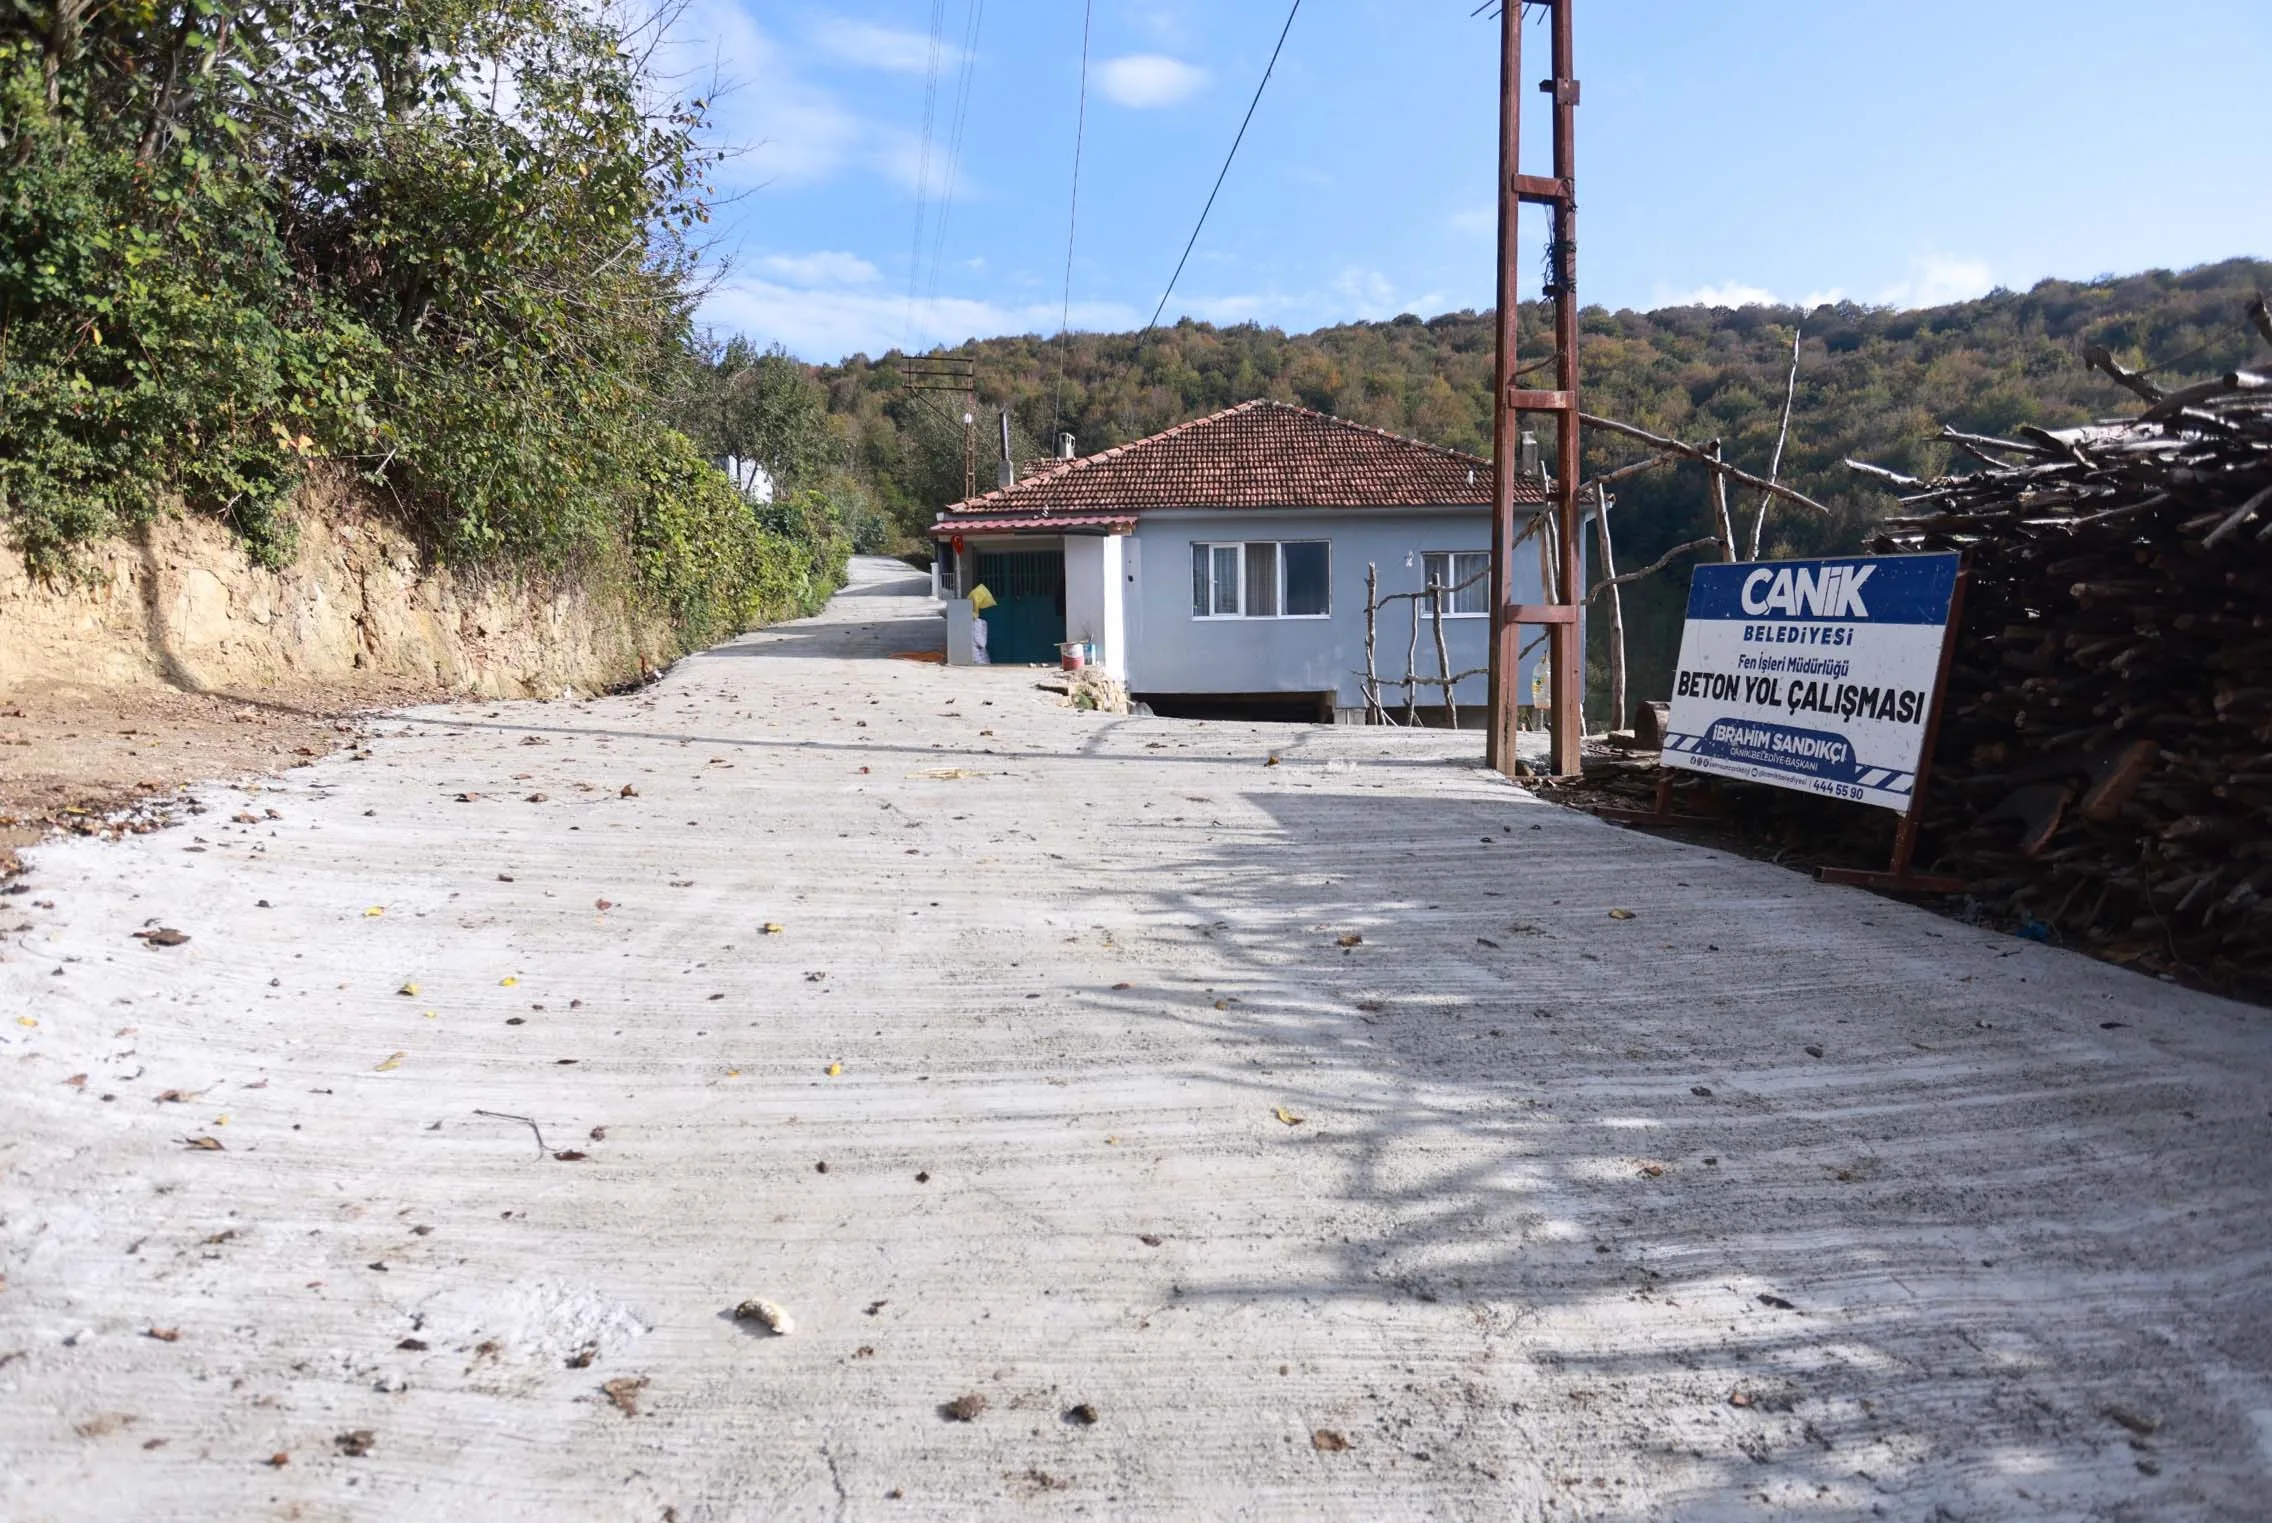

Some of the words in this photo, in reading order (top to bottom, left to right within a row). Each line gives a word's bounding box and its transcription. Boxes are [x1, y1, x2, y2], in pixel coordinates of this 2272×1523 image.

[1738, 654, 1757, 669] Fen
[1758, 651, 1786, 673] İşleri
[1787, 656, 1849, 680] Müdürlüğü
[1677, 671, 1740, 702] BETON
[1745, 676, 1782, 707] YOL
[1787, 679, 1926, 724] ÇALIŞMASI
[1712, 724, 1771, 749] İBRAHİM
[1771, 733, 1848, 765] SANDIKÇI
[1751, 750, 1785, 765] BELEDİYE
[1785, 757, 1819, 772] BAŞKANI
[1813, 779, 1834, 794] 444
[1835, 783, 1849, 797] 55
[1850, 786, 1864, 800] 90
